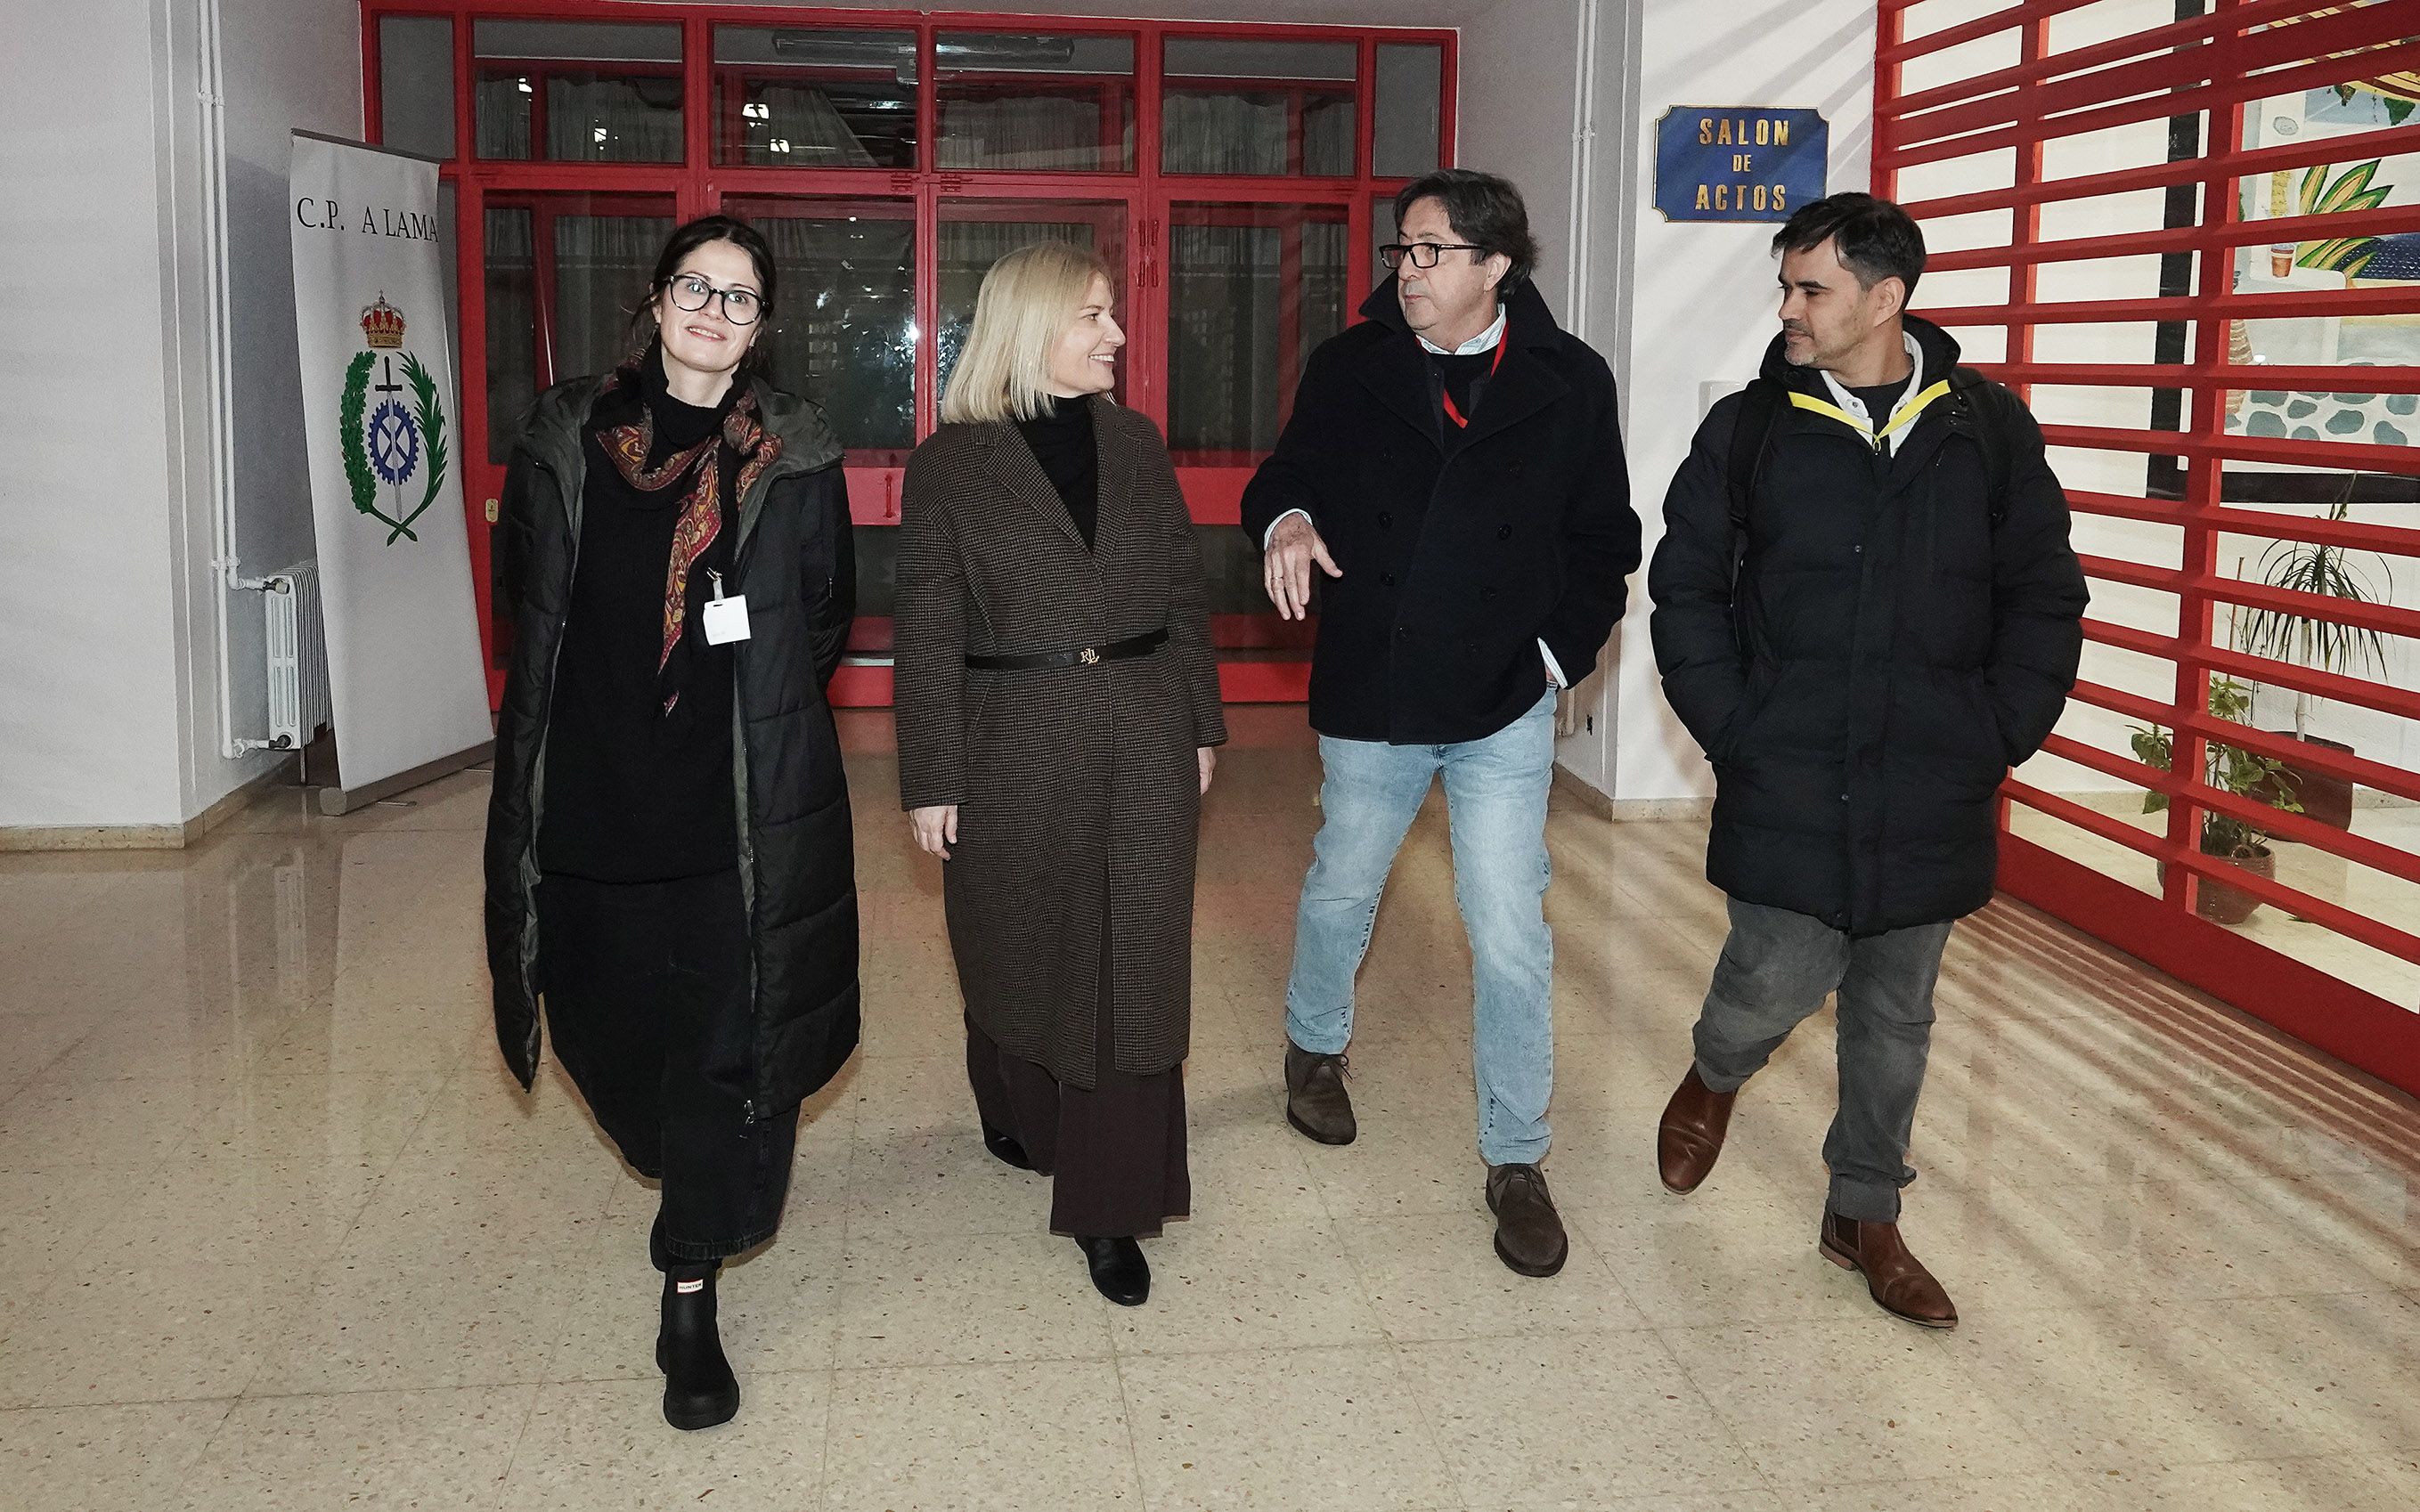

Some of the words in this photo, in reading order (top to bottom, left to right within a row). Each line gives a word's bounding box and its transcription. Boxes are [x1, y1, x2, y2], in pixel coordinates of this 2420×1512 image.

[1699, 118, 1789, 146] SALON
[1732, 154, 1752, 172] DE
[1695, 184, 1786, 211] ACTOS
[297, 197, 345, 231] C.P.
